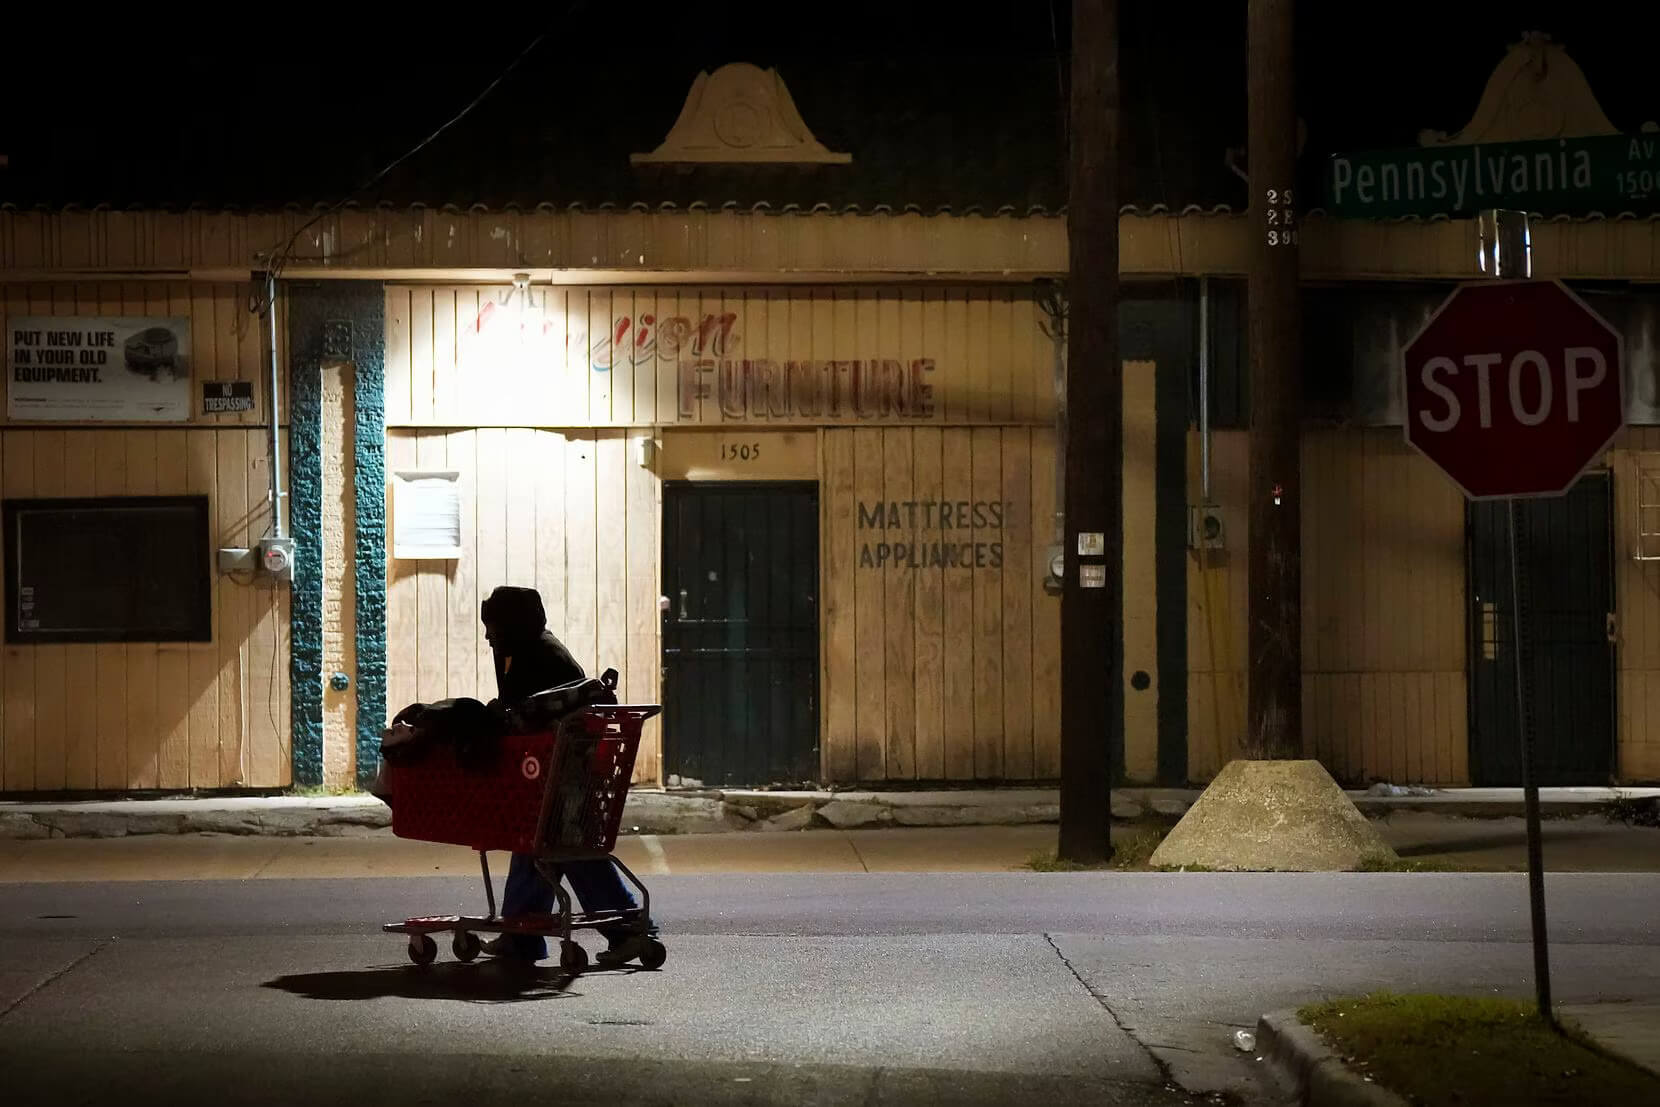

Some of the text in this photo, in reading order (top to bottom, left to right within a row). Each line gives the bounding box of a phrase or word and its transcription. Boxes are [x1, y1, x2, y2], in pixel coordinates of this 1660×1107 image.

[1333, 138, 1592, 211] Pennsylvania
[13, 330, 115, 347] PUT NEW LIFE
[14, 349, 107, 365] IN YOUR OLD
[13, 367, 103, 383] EQUIPMENT.
[222, 383, 233, 397] NO
[677, 358, 936, 419] FURNITURE
[1419, 346, 1607, 433] STOP
[205, 397, 252, 411] TRESPASSING
[720, 443, 761, 461] 1505
[858, 542, 1003, 570] APPLIANCES
